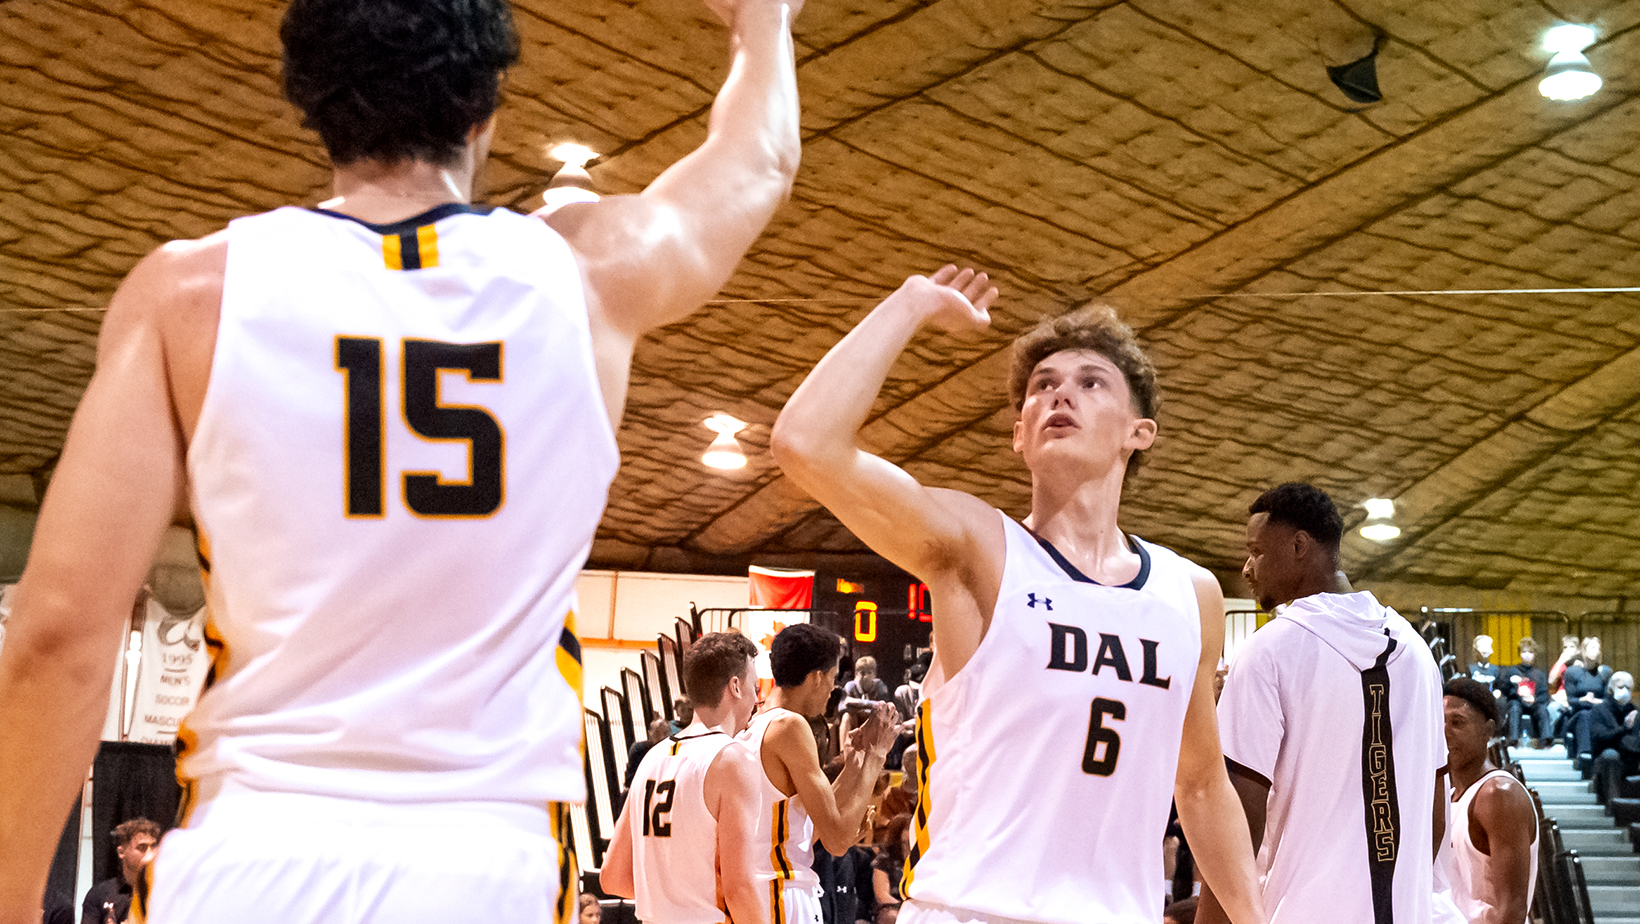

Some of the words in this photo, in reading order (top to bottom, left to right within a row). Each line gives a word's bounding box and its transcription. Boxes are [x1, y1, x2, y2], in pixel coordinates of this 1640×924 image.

[333, 333, 507, 521] 15
[854, 600, 878, 643] 0
[1044, 621, 1172, 690] DAL
[162, 652, 194, 666] 1995
[1081, 695, 1127, 777] 6
[1368, 683, 1395, 863] TIGERS
[643, 778, 676, 838] 12
